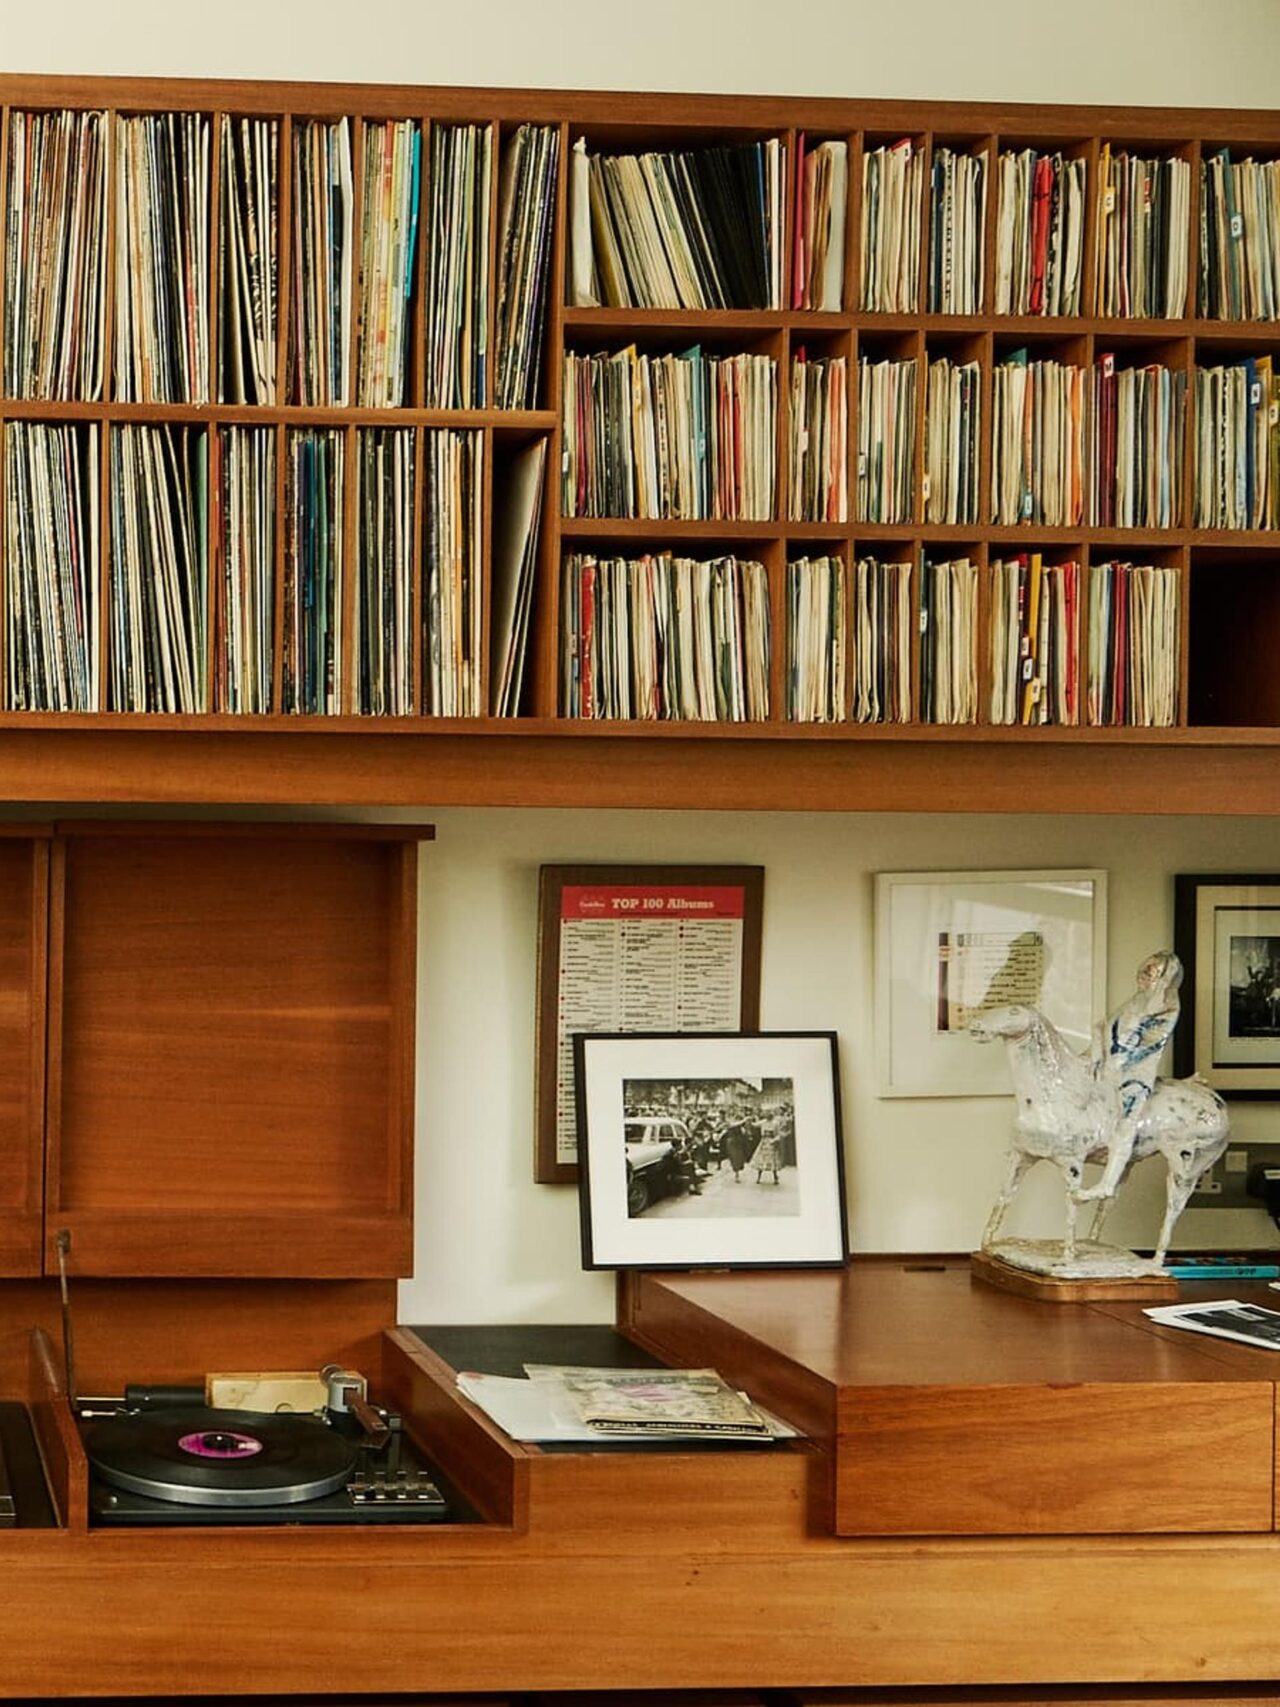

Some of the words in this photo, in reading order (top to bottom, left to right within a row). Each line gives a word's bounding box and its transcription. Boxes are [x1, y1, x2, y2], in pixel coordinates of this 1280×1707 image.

[611, 898, 639, 909] TOP
[643, 898, 664, 909] 100
[667, 897, 715, 910] Albums
